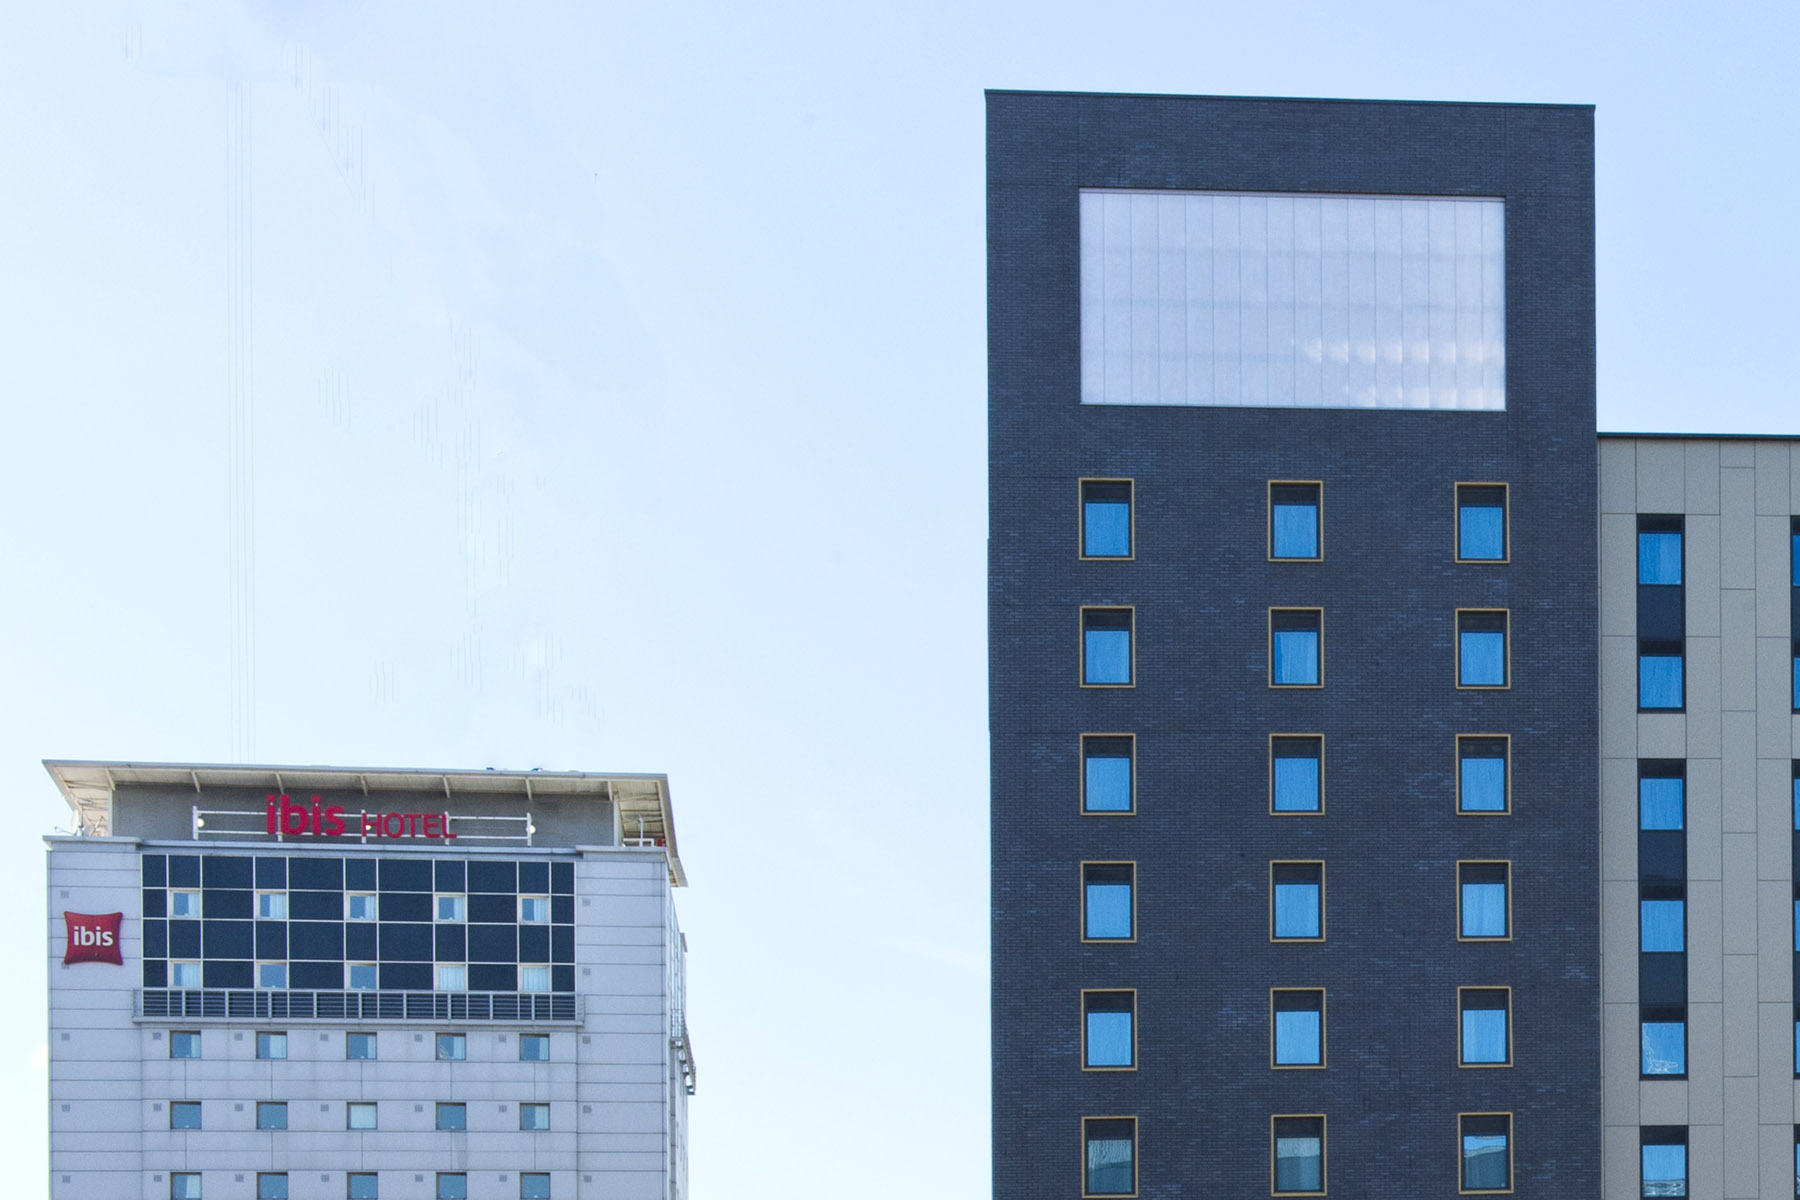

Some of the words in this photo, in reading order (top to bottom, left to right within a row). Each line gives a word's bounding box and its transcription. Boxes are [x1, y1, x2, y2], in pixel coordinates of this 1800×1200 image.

[266, 794, 346, 836] ibis
[361, 812, 457, 839] HOTEL
[73, 925, 114, 947] ibis
